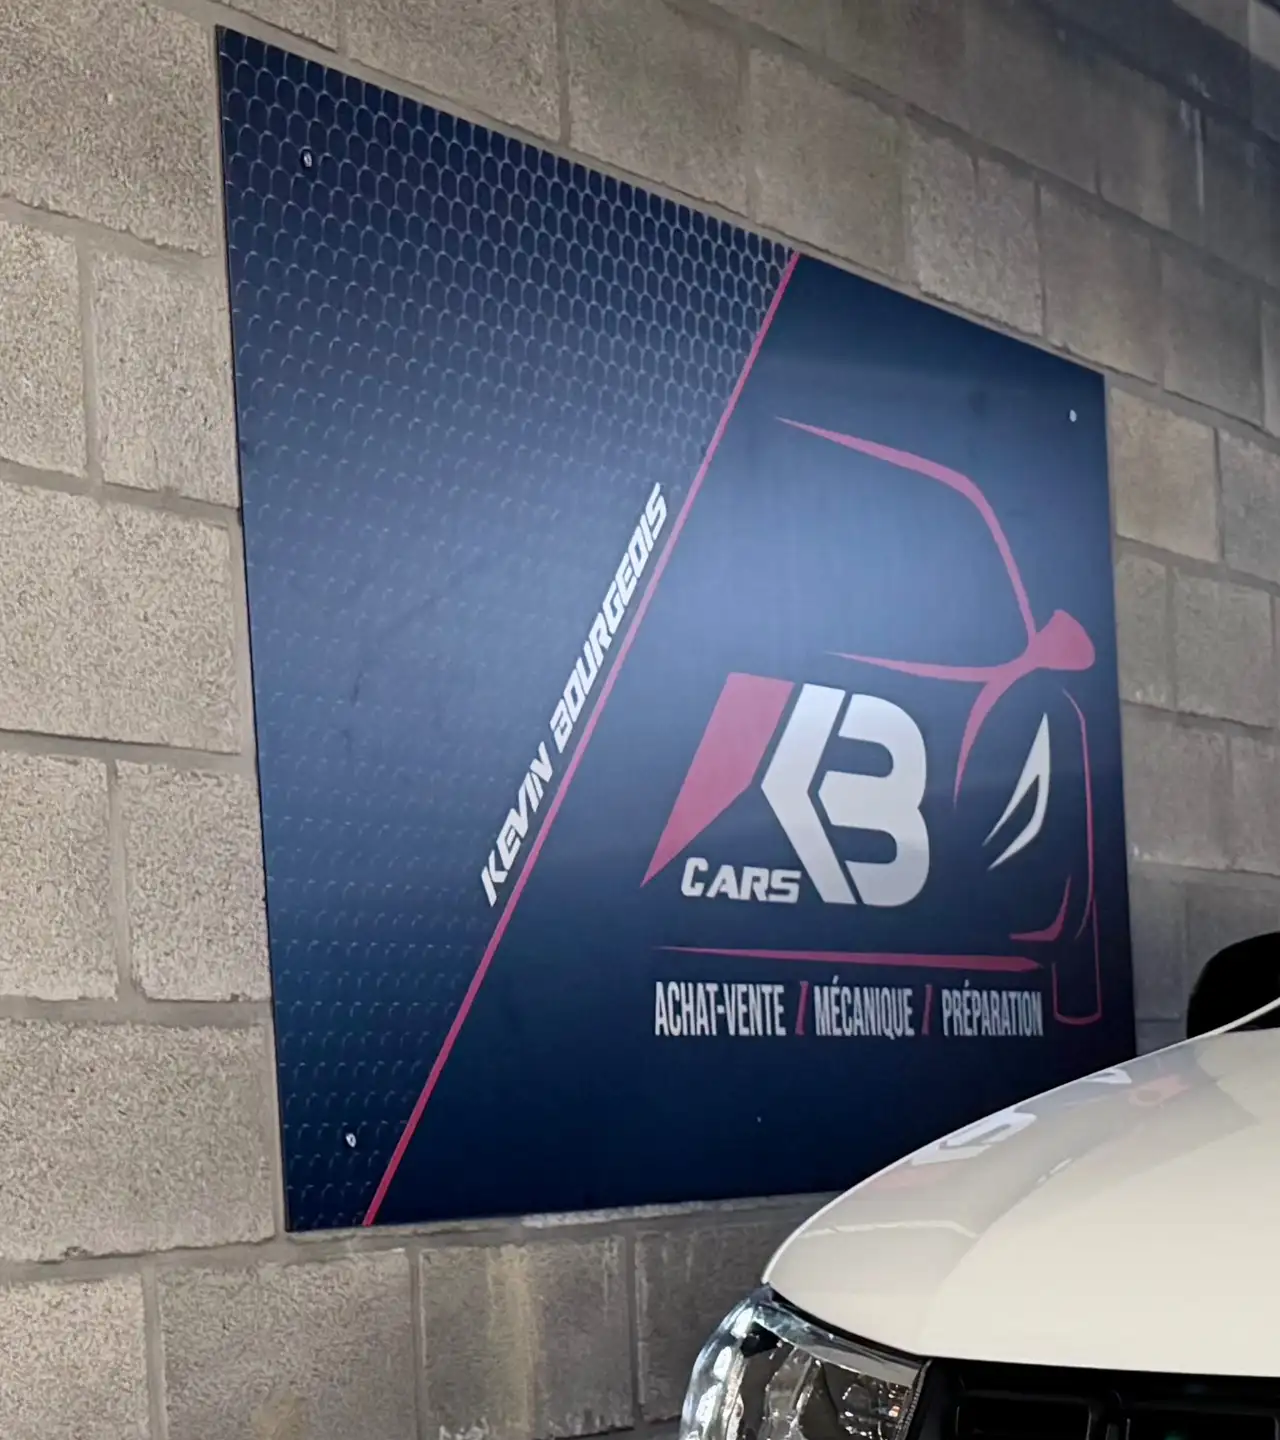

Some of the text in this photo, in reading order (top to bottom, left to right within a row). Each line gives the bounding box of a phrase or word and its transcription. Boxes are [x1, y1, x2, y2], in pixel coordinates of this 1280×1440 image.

[481, 482, 668, 906] KEVIN BOURGEOIS
[681, 857, 801, 903] CARS
[654, 981, 787, 1036] ACHAT-VENTE
[814, 975, 915, 1040] MÉCANIQUE
[942, 980, 1044, 1036] PRÉPARATION
